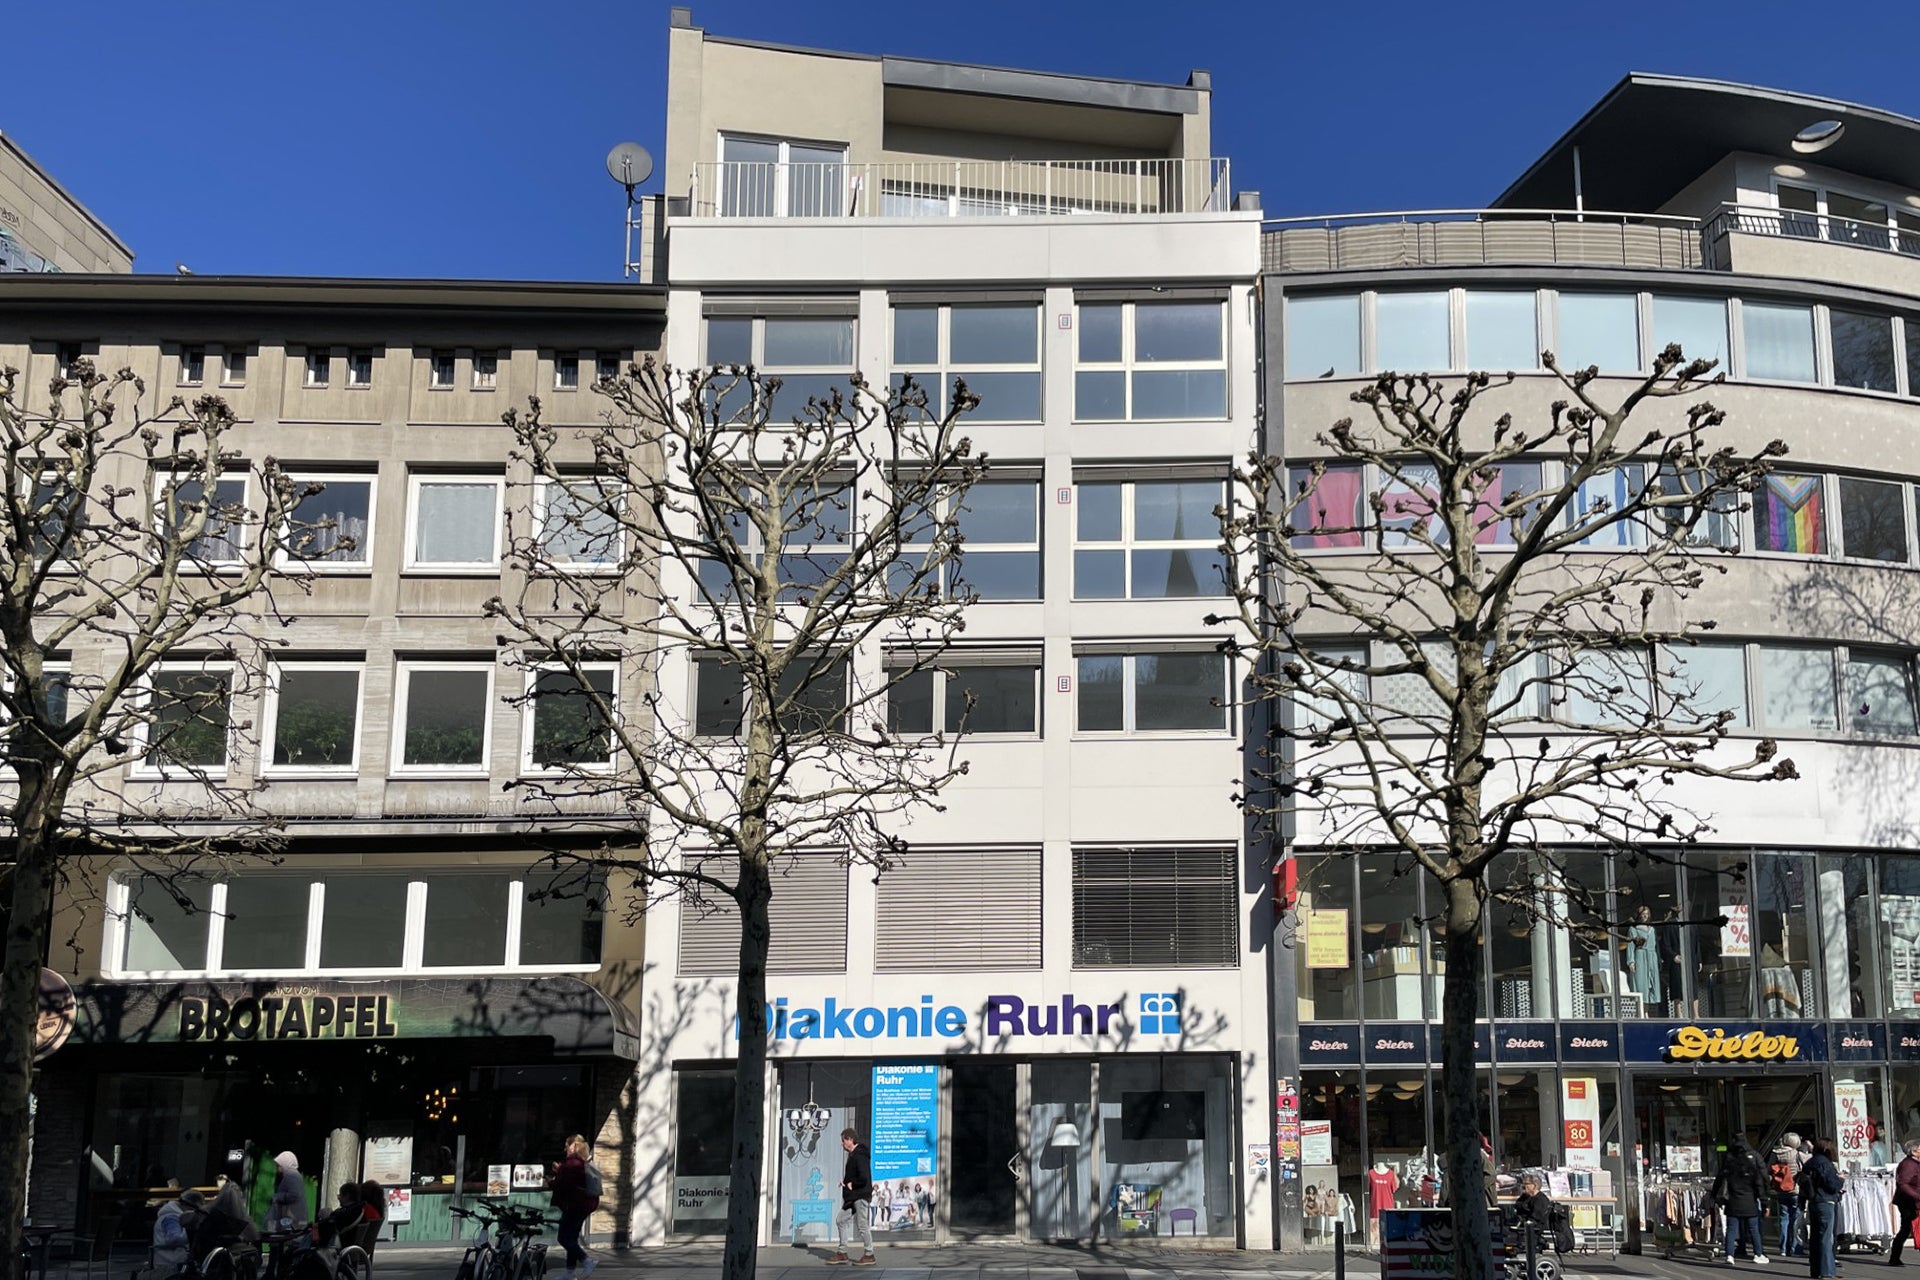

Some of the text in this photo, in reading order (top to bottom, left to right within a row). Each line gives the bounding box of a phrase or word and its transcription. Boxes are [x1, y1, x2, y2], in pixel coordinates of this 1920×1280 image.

[180, 996, 396, 1040] BROTAPFEL
[735, 994, 1121, 1040] iakonie Ruhr
[1309, 1039, 1349, 1050] Dieler
[1375, 1039, 1414, 1050] Dieler
[1506, 1037, 1545, 1048] Dieler
[1570, 1037, 1608, 1048] Dieler
[1670, 1025, 1800, 1059] Dieler
[1841, 1036, 1873, 1047] Dieler
[876, 1075, 904, 1085] Ruhr
[1570, 1128, 1587, 1140] 80
[1856, 1124, 1876, 1140] 80
[678, 1187, 723, 1197] Diakonie
[678, 1199, 703, 1208] Ruhr
